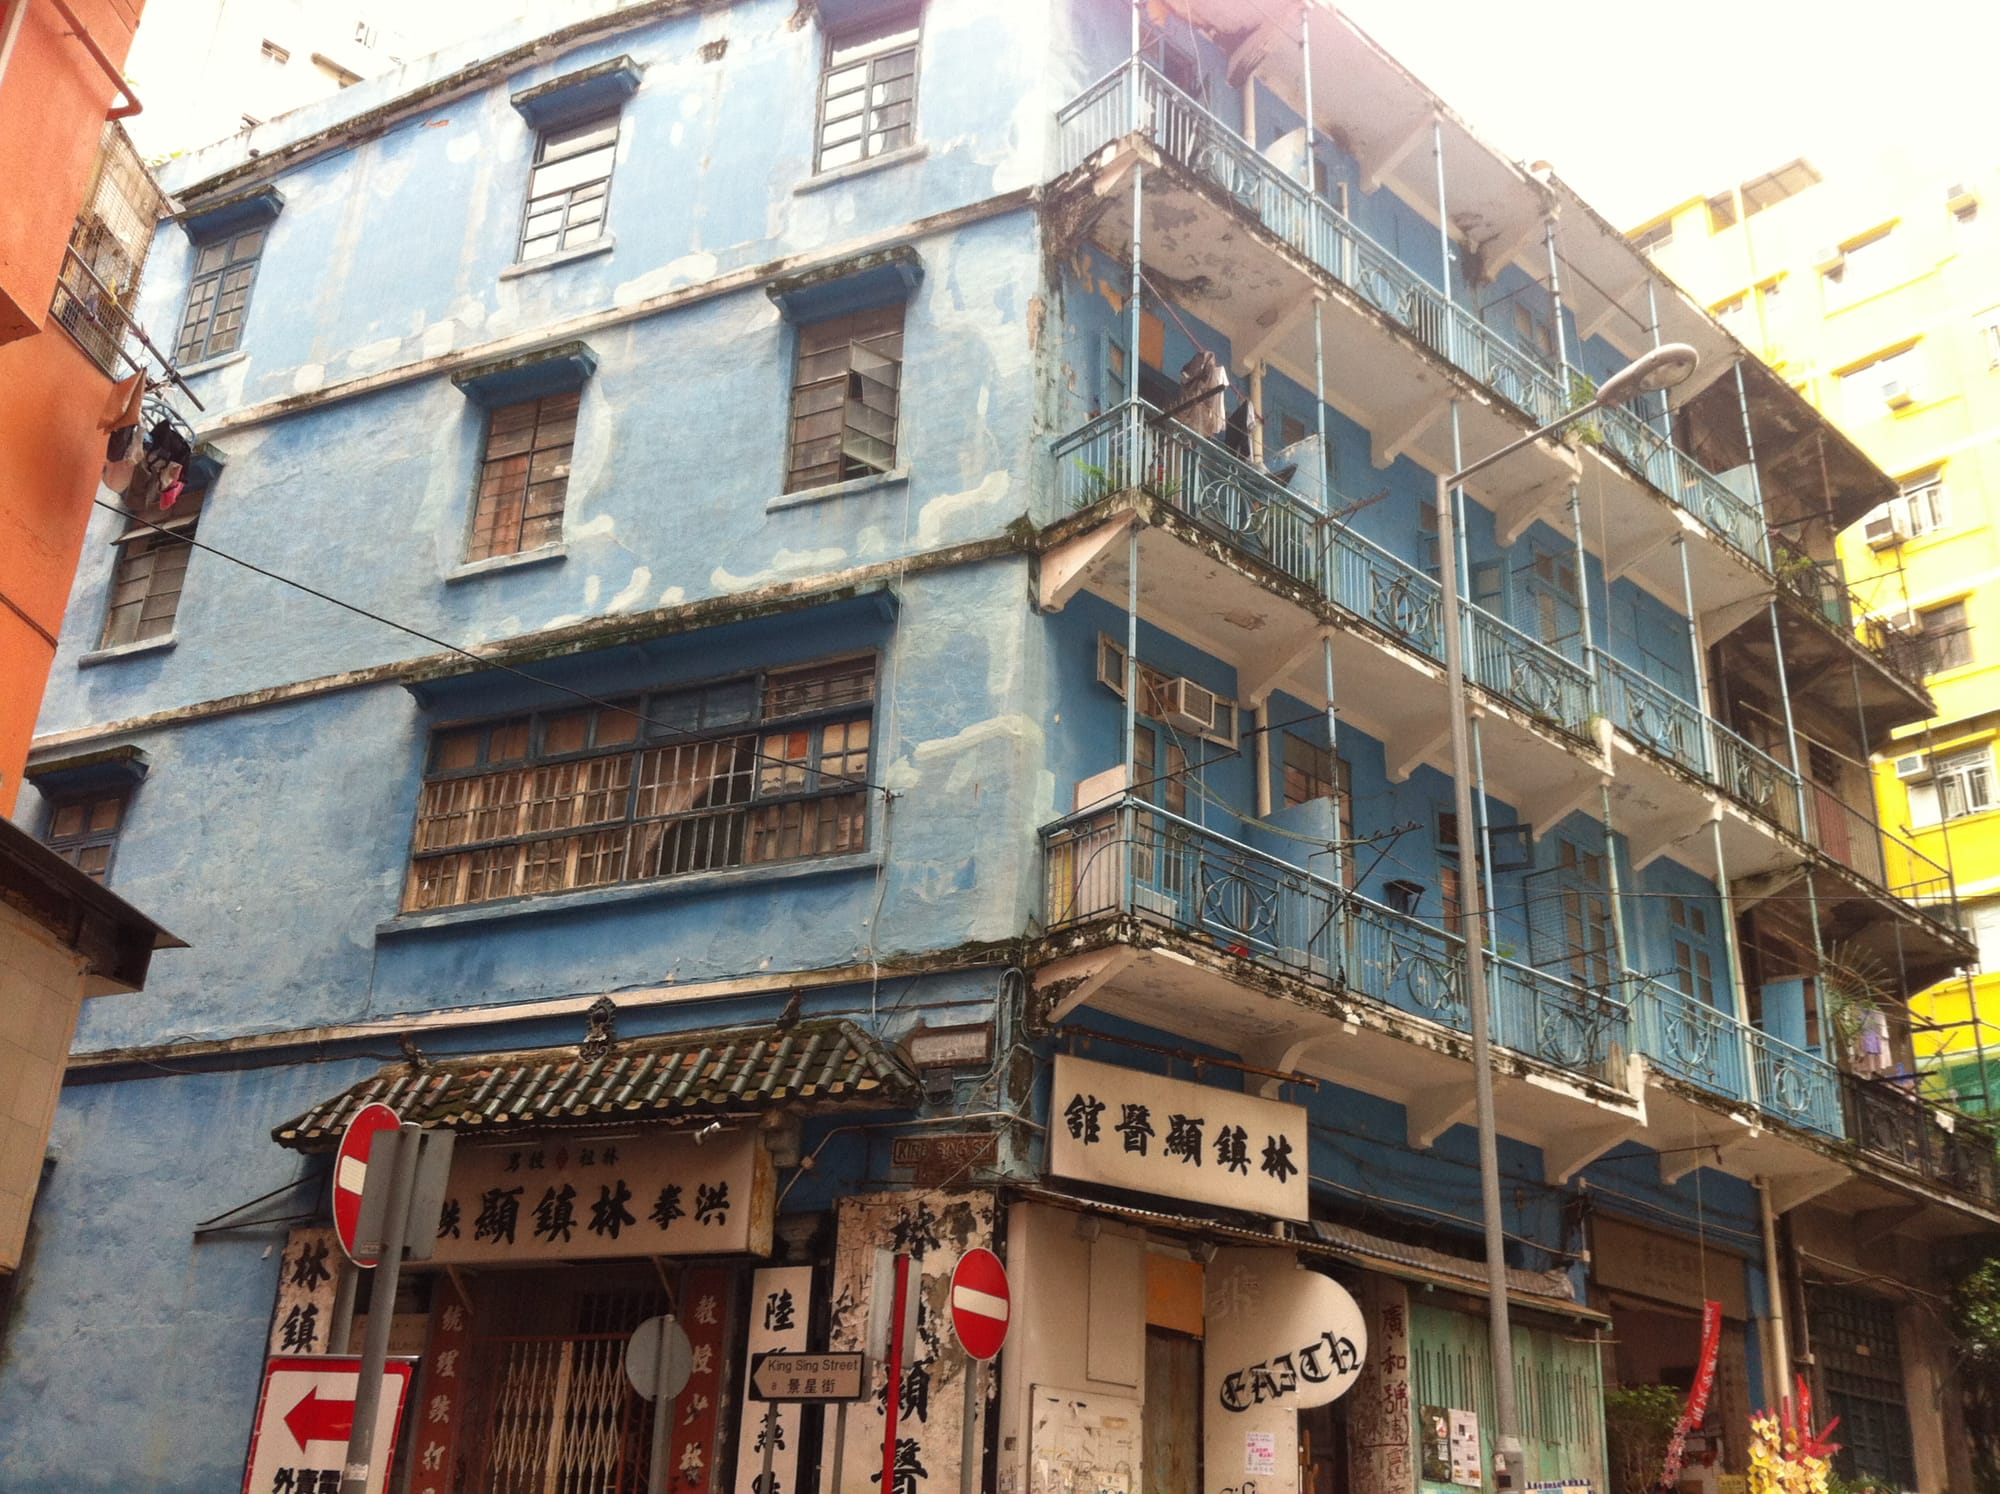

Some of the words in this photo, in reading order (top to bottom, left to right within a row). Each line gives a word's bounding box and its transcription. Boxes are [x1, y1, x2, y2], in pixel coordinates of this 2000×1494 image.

[768, 1360, 792, 1373] King
[795, 1360, 819, 1373] Sing
[822, 1360, 858, 1372] Street
[786, 1378, 836, 1394] 景星街
